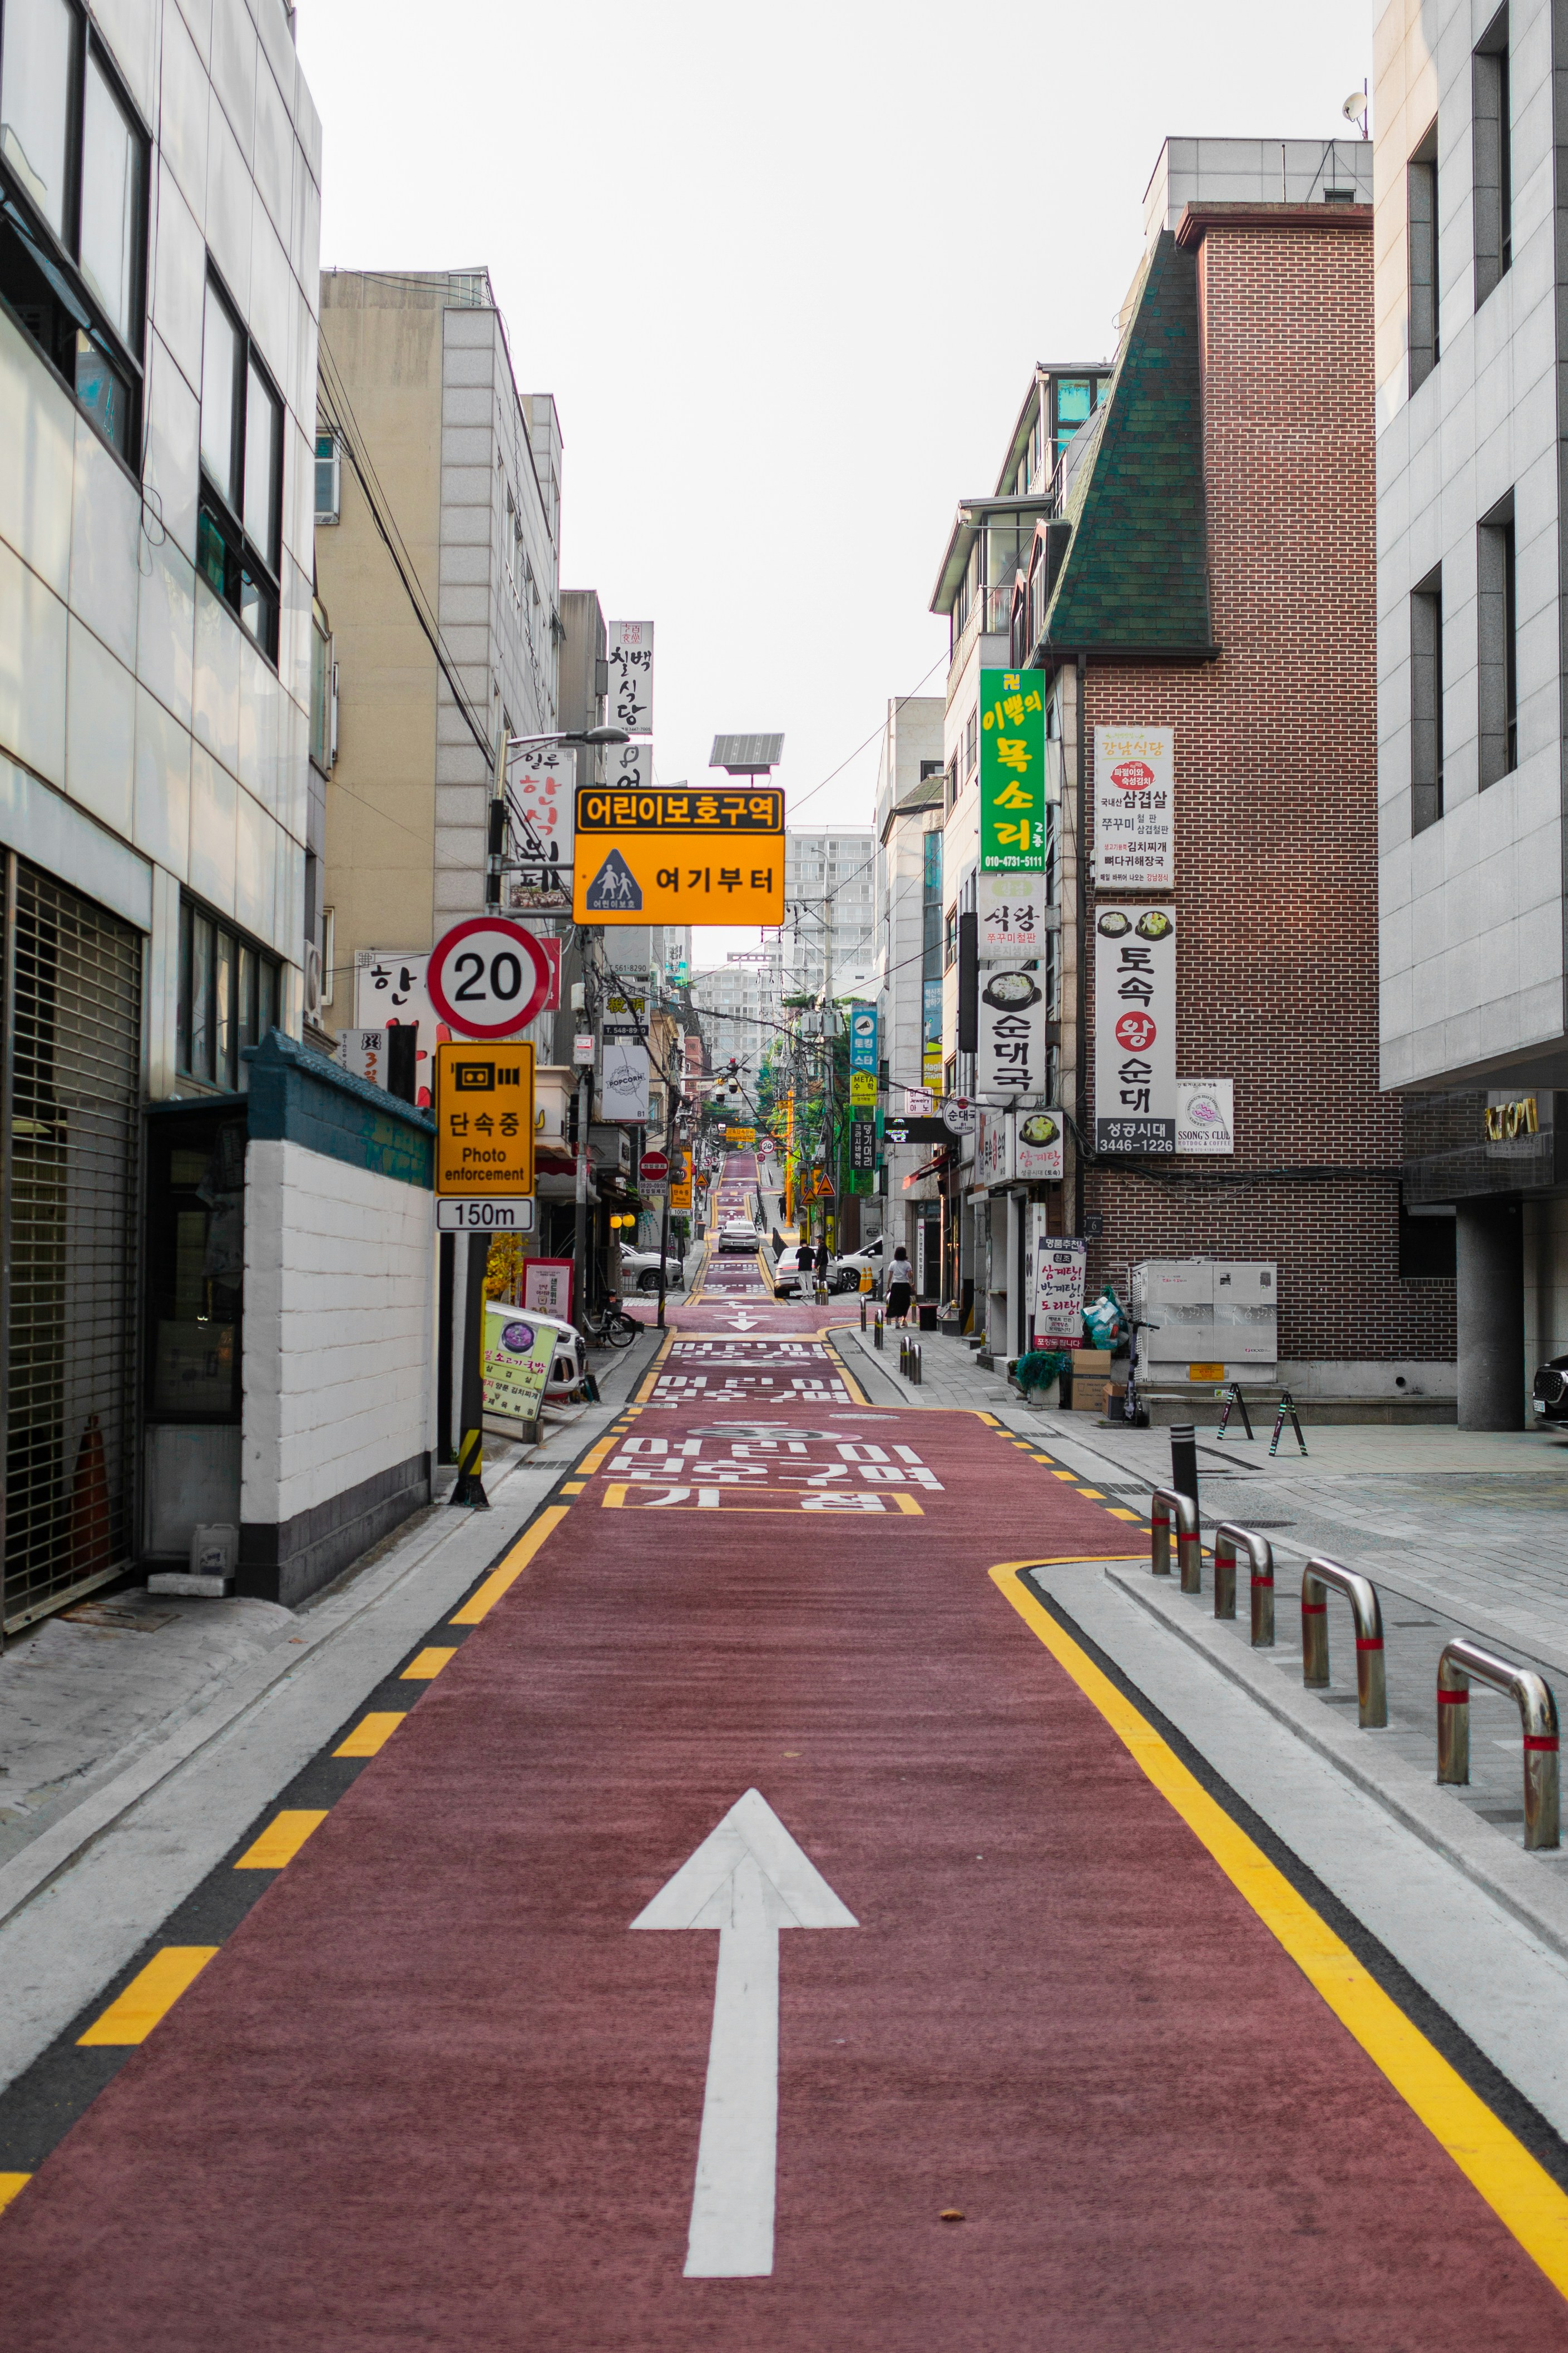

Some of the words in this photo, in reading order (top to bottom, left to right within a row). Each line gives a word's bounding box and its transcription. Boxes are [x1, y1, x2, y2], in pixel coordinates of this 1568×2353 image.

[610, 646, 652, 677] 칠백
[617, 679, 647, 726] 식당
[982, 690, 1042, 731] 이쁨의
[1102, 741, 1164, 756] 강남식당
[525, 753, 560, 770] 일루
[1114, 768, 1144, 777] 파절이와
[1121, 777, 1151, 786] 숙성김치
[993, 737, 1033, 851] 목소리
[1101, 798, 1122, 807] 국내산
[1122, 791, 1168, 809] 삼겹살
[519, 775, 562, 836] 한식
[586, 795, 774, 827] 어린이보호구역
[1102, 818, 1134, 831] 쭈꾸미
[1137, 813, 1156, 823] 철판
[1032, 822, 1043, 848] 2층
[1137, 825, 1169, 835] 삼겹철판
[1127, 841, 1166, 852] 김치찌개
[985, 856, 1042, 867] 010-4731-5111
[1105, 855, 1164, 866] 뼈다귀해장국
[656, 866, 773, 894] 여기부터
[1146, 874, 1168, 882] 강남정식
[593, 900, 636, 909] 어린이보호
[984, 905, 1040, 932] 식당
[987, 933, 1036, 944] 쭈꾸미철판
[454, 952, 522, 1002] 20
[1117, 948, 1154, 1007] 토속
[854, 1038, 873, 1048] 토킹
[854, 1055, 873, 1065] 스타
[992, 1015, 1033, 1092] 순대국
[610, 1075, 642, 1087] POPCORN
[1118, 1058, 1152, 1113] 순대
[451, 1113, 519, 1136] 단속중
[1189, 1117, 1206, 1127] COFFEE
[1107, 1123, 1166, 1138] 성공시대
[1178, 1131, 1209, 1139] SSONG'S
[1100, 1139, 1173, 1152] 3446-1226
[462, 1147, 506, 1162] Photo
[1020, 1150, 1061, 1167] 삼계탕
[445, 1167, 524, 1181] enforcement
[455, 1203, 515, 1225] 150m
[1092, 1221, 1097, 1230] 6
[1046, 1239, 1079, 1250] 명품추천
[1042, 1264, 1082, 1281] 삼계탕!
[1041, 1281, 1081, 1298] 반계탕!
[1042, 1300, 1080, 1315] 도리탕!
[670, 1351, 829, 1359] 보호구역
[672, 1343, 824, 1352] 어린이
[657, 1375, 844, 1389] 어린이
[511, 1387, 538, 1400] 김치찌개
[650, 1389, 852, 1404] 보호구역
[621, 1438, 923, 1463] 어린이
[601, 1456, 945, 1490] 보호구역
